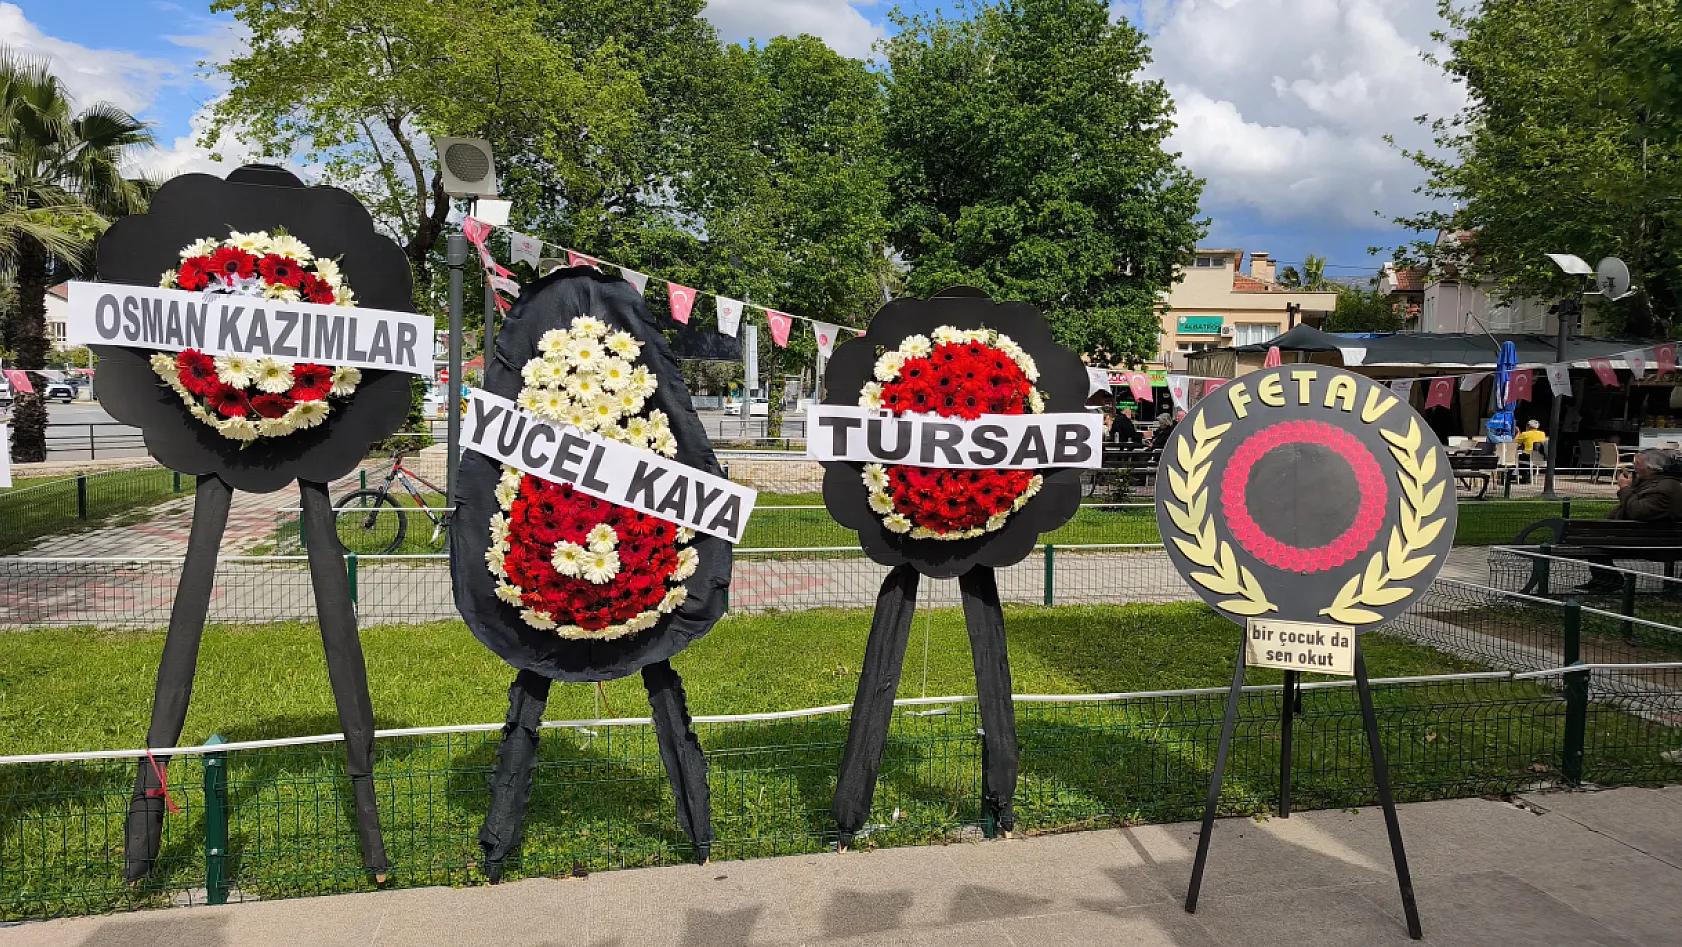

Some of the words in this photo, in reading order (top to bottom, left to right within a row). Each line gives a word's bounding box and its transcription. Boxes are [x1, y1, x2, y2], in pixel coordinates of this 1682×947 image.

[95, 293, 208, 349] OSMAN
[217, 304, 418, 368] KAZIMLAR
[1228, 370, 1400, 423] FETAV
[818, 411, 1092, 466] TÜRSAB
[471, 397, 610, 494] YÜCEL
[625, 460, 742, 538] KAYA
[1252, 624, 1274, 641] bir
[1279, 630, 1325, 647] çocuk
[1331, 631, 1349, 648] da
[1266, 649, 1292, 663] sen
[1298, 648, 1334, 667] okut
